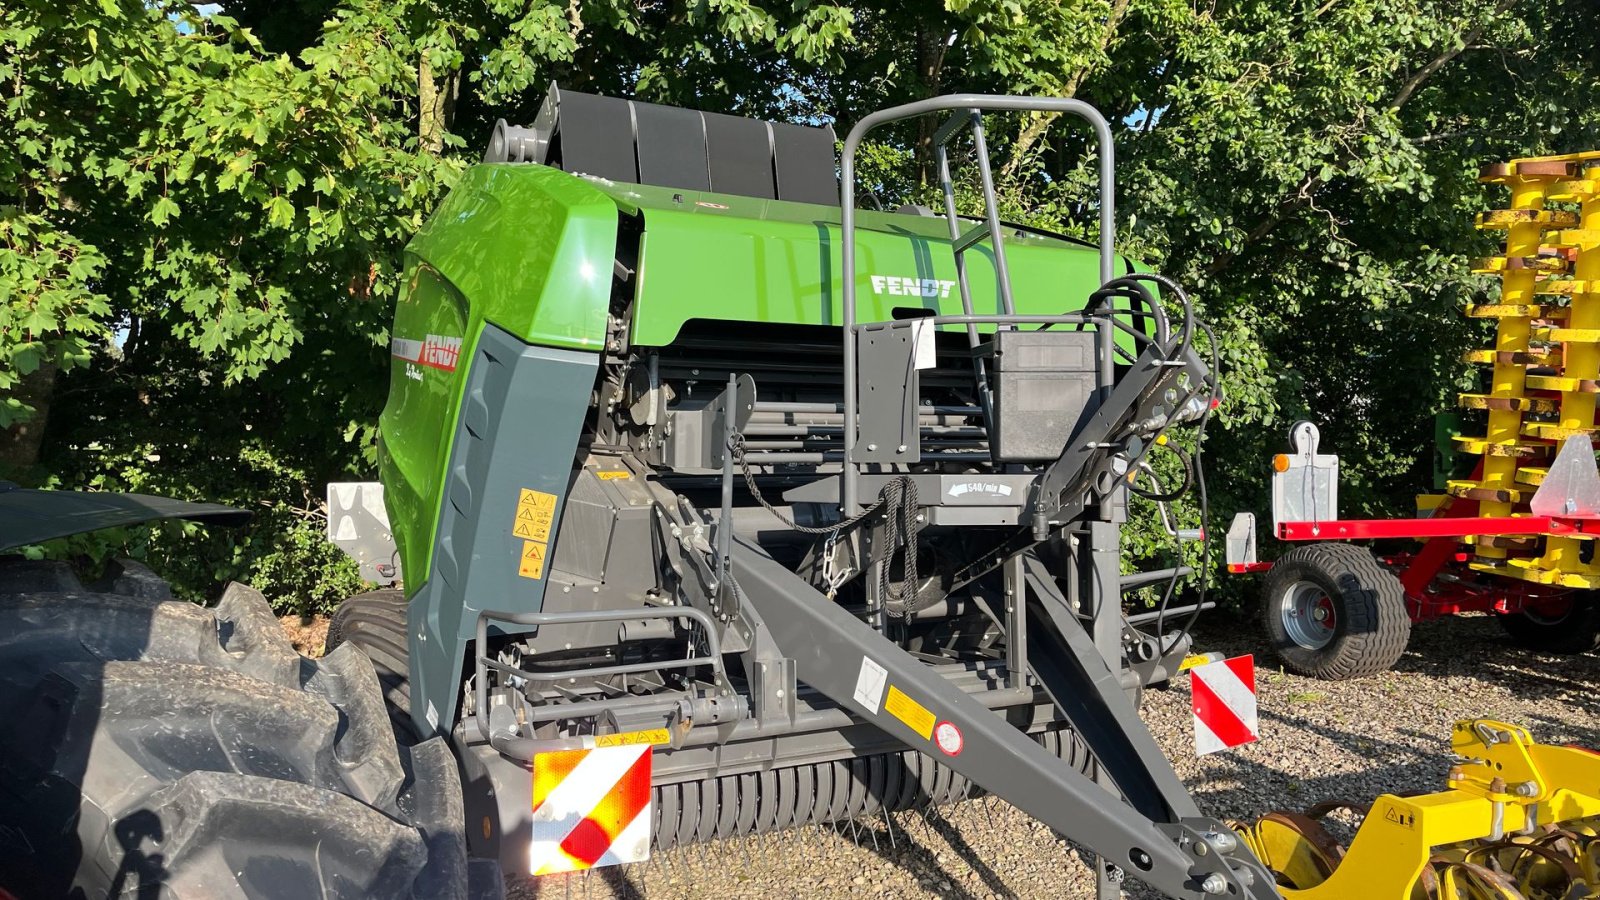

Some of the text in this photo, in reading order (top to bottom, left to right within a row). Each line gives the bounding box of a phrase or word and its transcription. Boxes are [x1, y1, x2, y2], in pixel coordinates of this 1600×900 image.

[871, 275, 955, 298] FENDT
[424, 334, 463, 368] FENDT
[967, 482, 999, 494] 540/min
